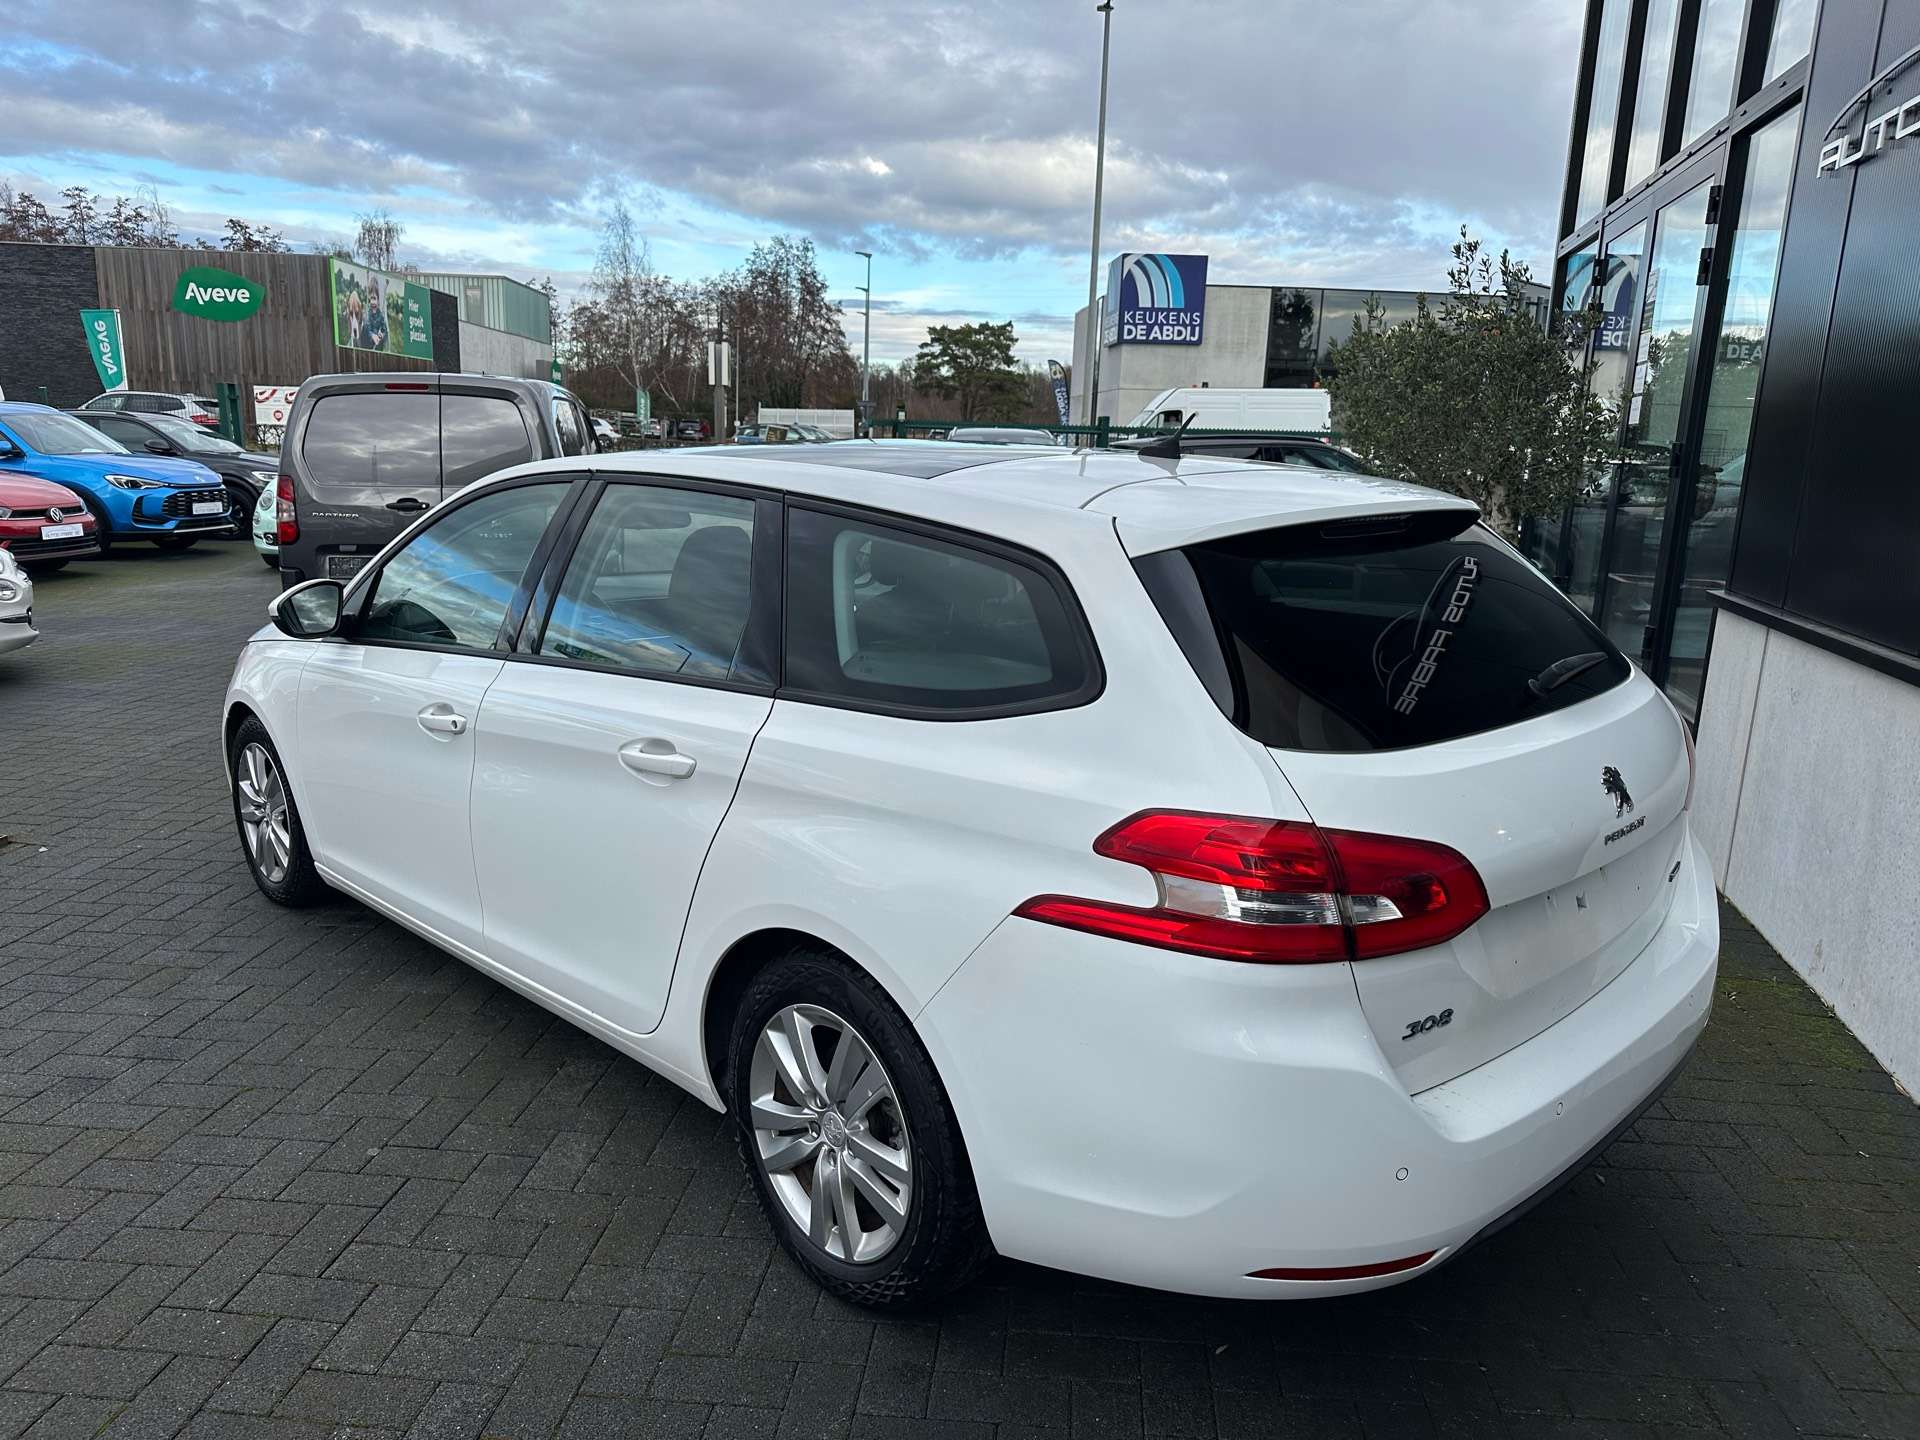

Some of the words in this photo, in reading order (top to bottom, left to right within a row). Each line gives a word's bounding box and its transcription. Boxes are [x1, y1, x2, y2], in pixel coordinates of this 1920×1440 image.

[184, 282, 250, 305] Aveve
[1124, 311, 1200, 325] KEUKENS
[1123, 325, 1147, 340] DE
[1149, 325, 1200, 341] ABDIJ
[1401, 1008, 1454, 1041] 308
